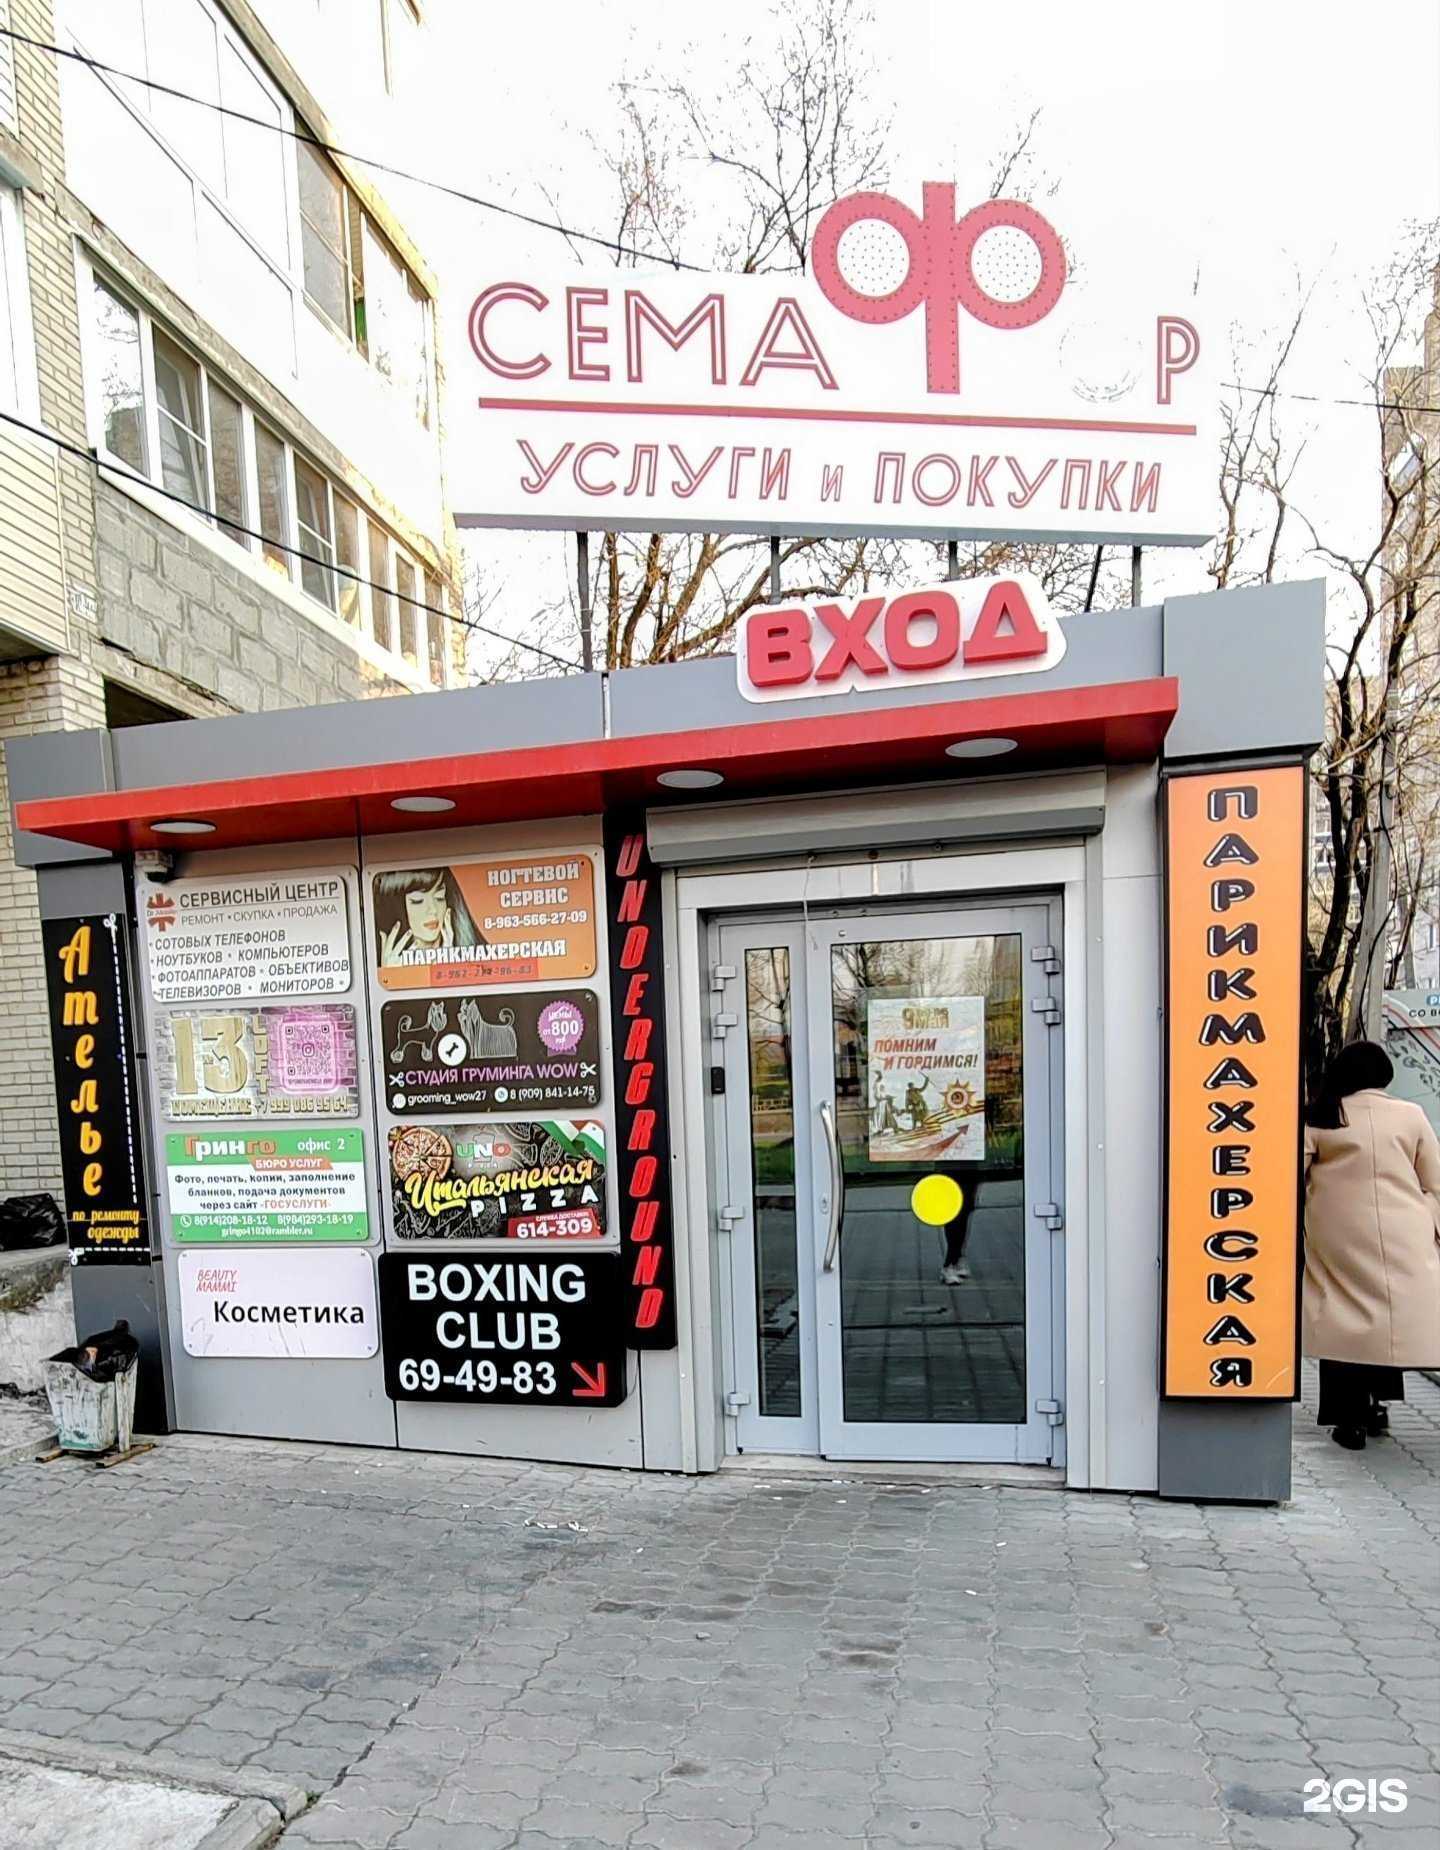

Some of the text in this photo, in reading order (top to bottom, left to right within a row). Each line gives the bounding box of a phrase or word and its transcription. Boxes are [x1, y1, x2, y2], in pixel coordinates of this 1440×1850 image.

[517, 440, 1162, 513] УСЛУГИ и ПОКУПКИ
[746, 580, 1049, 688] ВХОД
[487, 860, 579, 887] НОГТЕВОЙ
[180, 881, 338, 908] СЕРВИСНЫЙ ЦЕНТР
[181, 904, 338, 926] РЕМОНТ СКУПКА ПРОДАЖА
[155, 930, 286, 951] СОТОВЫХ ТЕЛЕФОНОВ
[156, 944, 329, 967] НОУТБУКОВ КОМПЬЮТЕРОВ
[402, 939, 567, 966] ПАРИКМАХЕРСКАЯ
[158, 959, 349, 984] ФОТОАППАРАТОВ ОБЪЕКТИВОВ
[160, 977, 334, 999] ТЕЛЕВИЗОРОВ МОНИТОРОВ
[551, 1020, 579, 1036] 800
[171, 1015, 248, 1095] 13
[252, 1014, 270, 1095] LOFT
[874, 1038, 937, 1053] ПОМНИМ
[58, 925, 103, 1197] Ателье
[884, 1054, 978, 1071] И ГОРДИМСЯ!
[405, 1063, 578, 1086] СТУДИЯ ГРУМИНГА WOW
[616, 833, 664, 1329] UNDERGROUND
[510, 1085, 595, 1100] 8 (909) 841-14-75
[1197, 785, 1266, 1389] ПАРИКМАХЕРСКАЯ
[407, 1091, 487, 1106] grooming_wow27
[298, 1138, 331, 1154] офис
[337, 1138, 345, 1150] 2
[456, 1142, 511, 1161] UNO
[255, 1157, 323, 1169] БЮРО УСЛУГ
[175, 1174, 205, 1184] Фото,
[207, 1174, 247, 1184] печать,
[288, 1172, 355, 1182] заполнение
[405, 1159, 593, 1217] Итальянская
[188, 1186, 346, 1197] бланков, подача документов
[200, 1201, 231, 1211] через
[233, 1199, 257, 1209] сайт
[91, 1209, 140, 1225] ремонту
[517, 1217, 593, 1239] 614-309
[87, 1226, 139, 1244] одежды
[197, 1269, 238, 1281] BEAUTY
[407, 1263, 587, 1303] BOXING
[196, 1281, 238, 1293] MAMMI
[214, 1300, 364, 1324] Косметика
[436, 1311, 561, 1350] CLUB
[399, 1358, 557, 1395] 69-49-83
